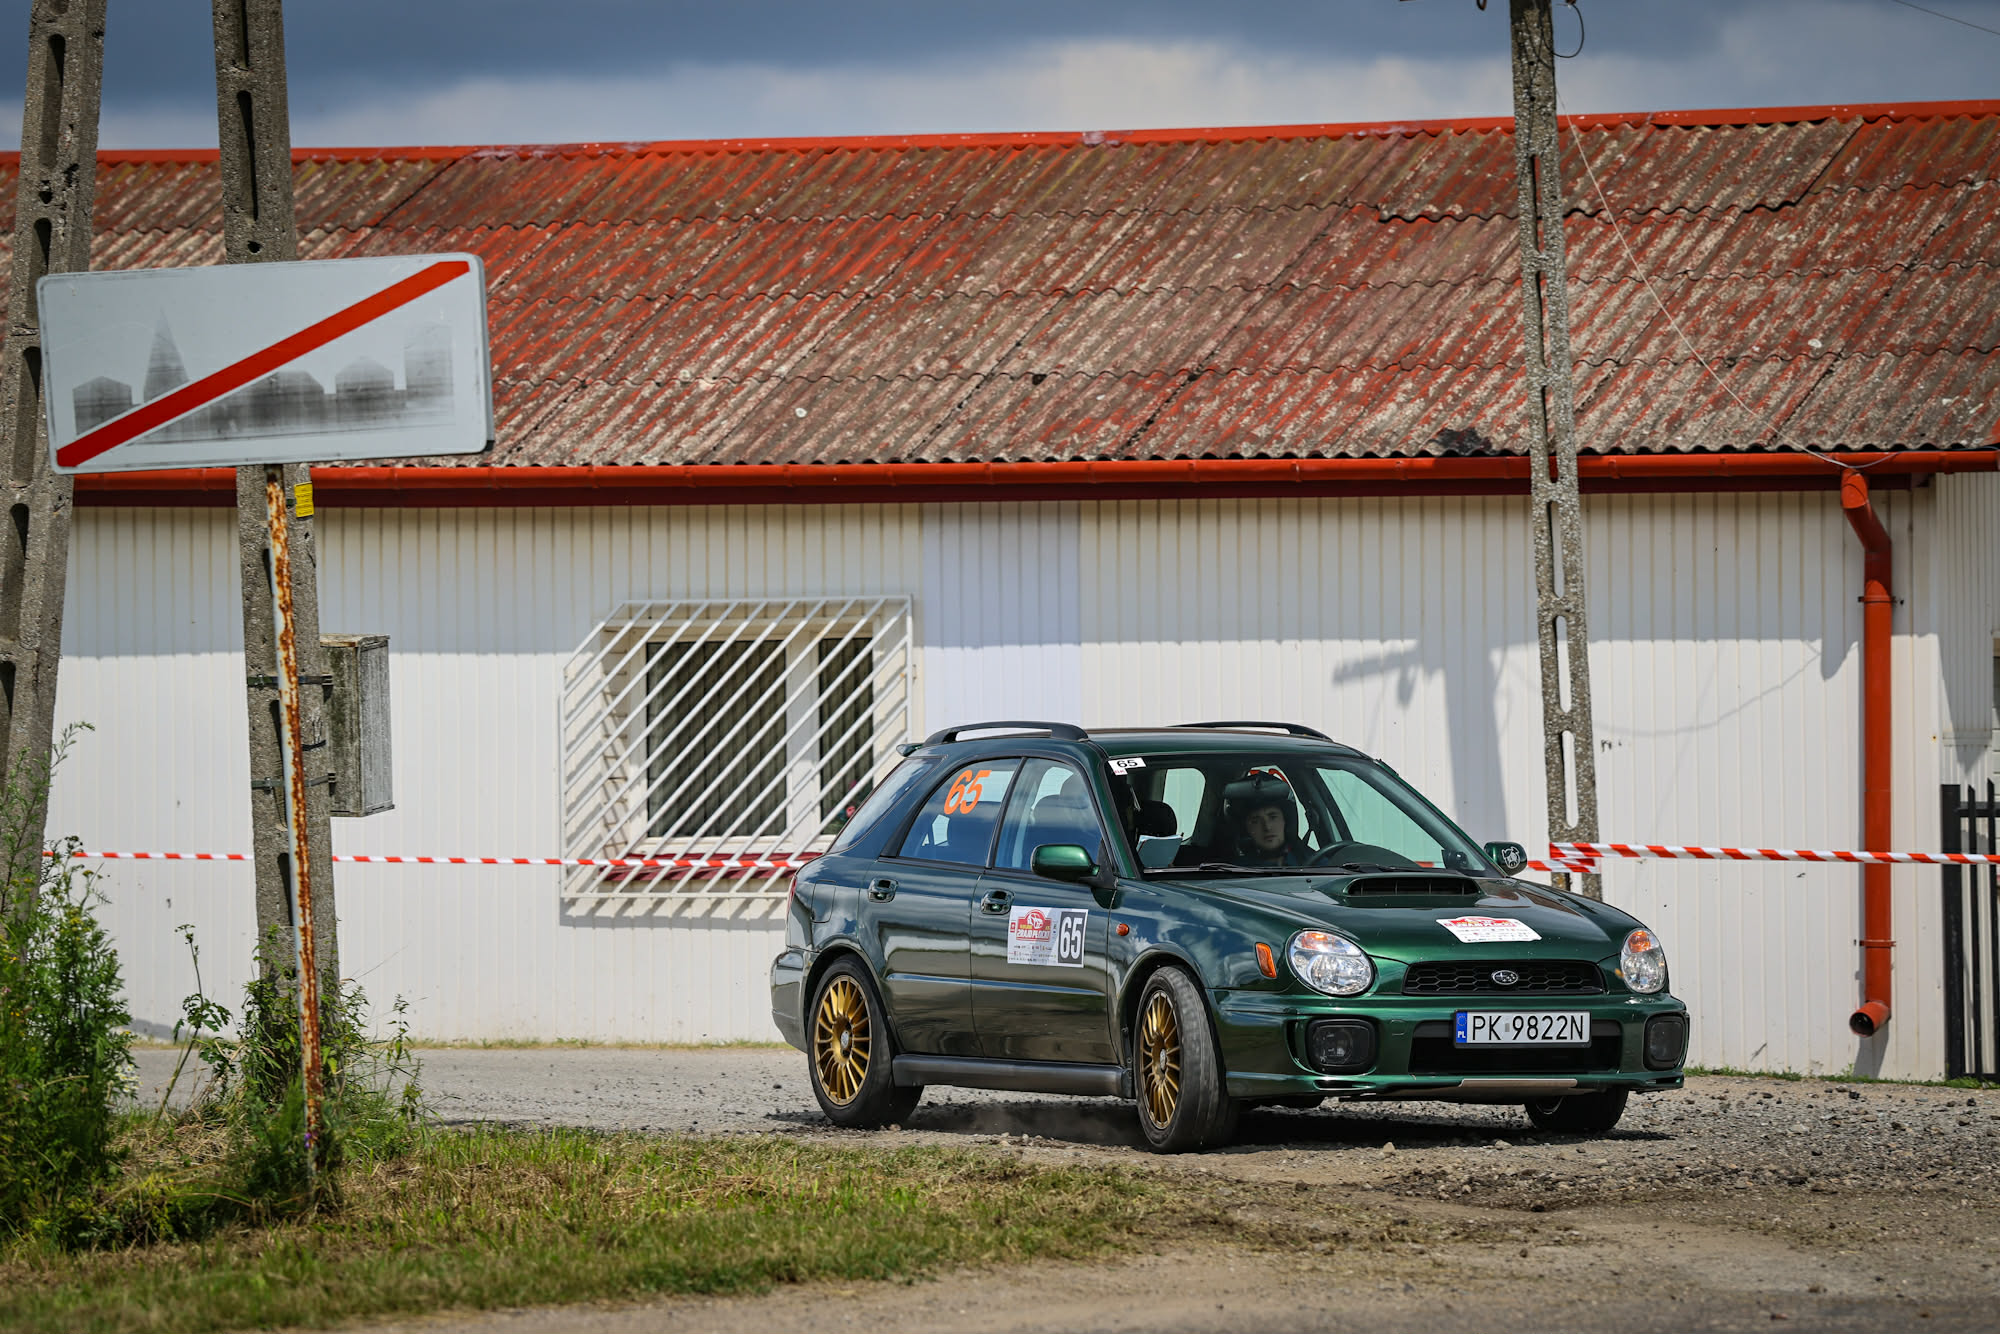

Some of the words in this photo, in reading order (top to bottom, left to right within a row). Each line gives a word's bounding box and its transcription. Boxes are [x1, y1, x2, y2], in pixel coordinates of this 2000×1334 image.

[944, 770, 992, 815] 65
[1060, 917, 1083, 959] 65
[1457, 1030, 1466, 1039] PL
[1472, 1015, 1502, 1041] PK
[1512, 1015, 1583, 1041] 9822N
